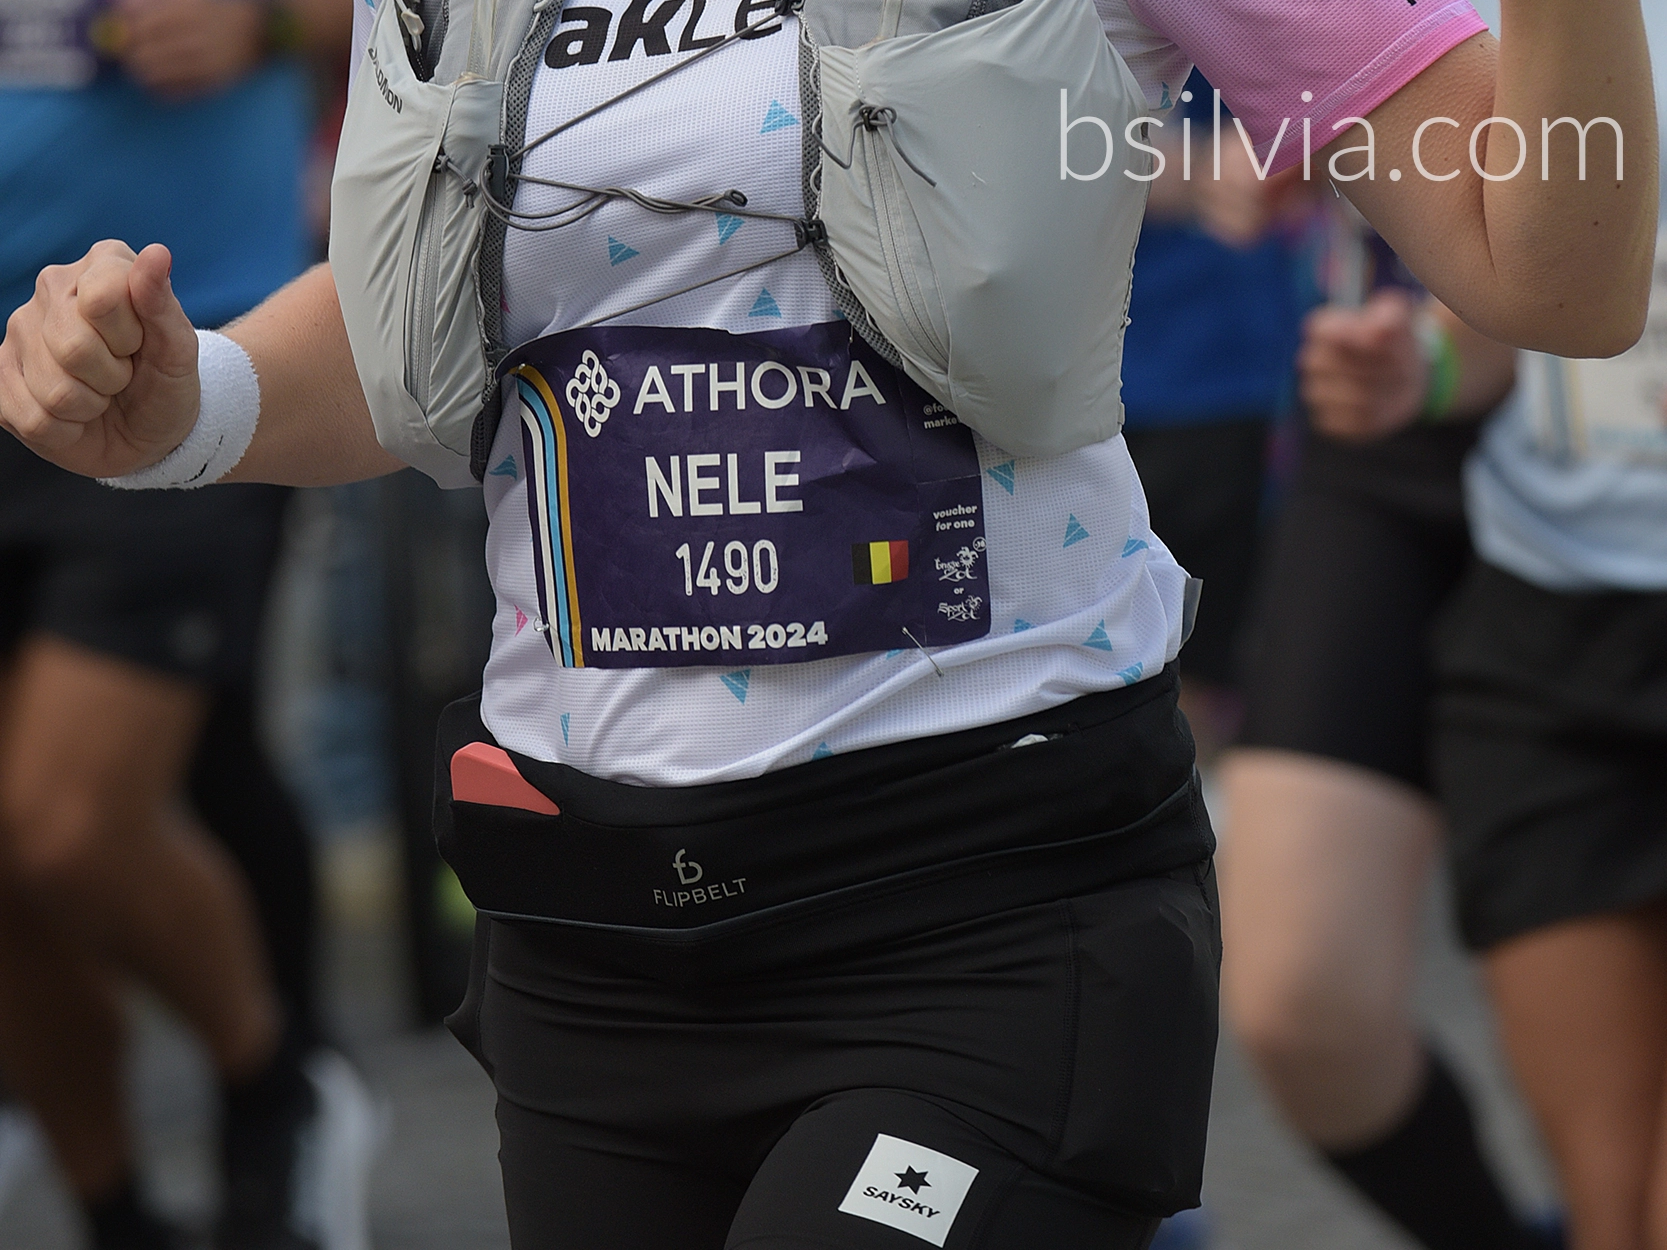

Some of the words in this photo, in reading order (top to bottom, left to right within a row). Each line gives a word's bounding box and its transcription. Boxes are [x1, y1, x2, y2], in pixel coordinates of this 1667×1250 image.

[633, 360, 886, 415] ATHORA
[923, 403, 946, 415] @fo
[924, 416, 958, 429] marke
[645, 451, 803, 518] NELE
[933, 504, 978, 520] voucher
[935, 521, 952, 532] for
[953, 519, 975, 529] one
[675, 539, 779, 596] 1490
[953, 587, 965, 595] or
[591, 623, 743, 652] MARATHON
[748, 621, 828, 649] 2024
[653, 878, 746, 907] FLIPBELT
[863, 1186, 940, 1218] SAYSKY
